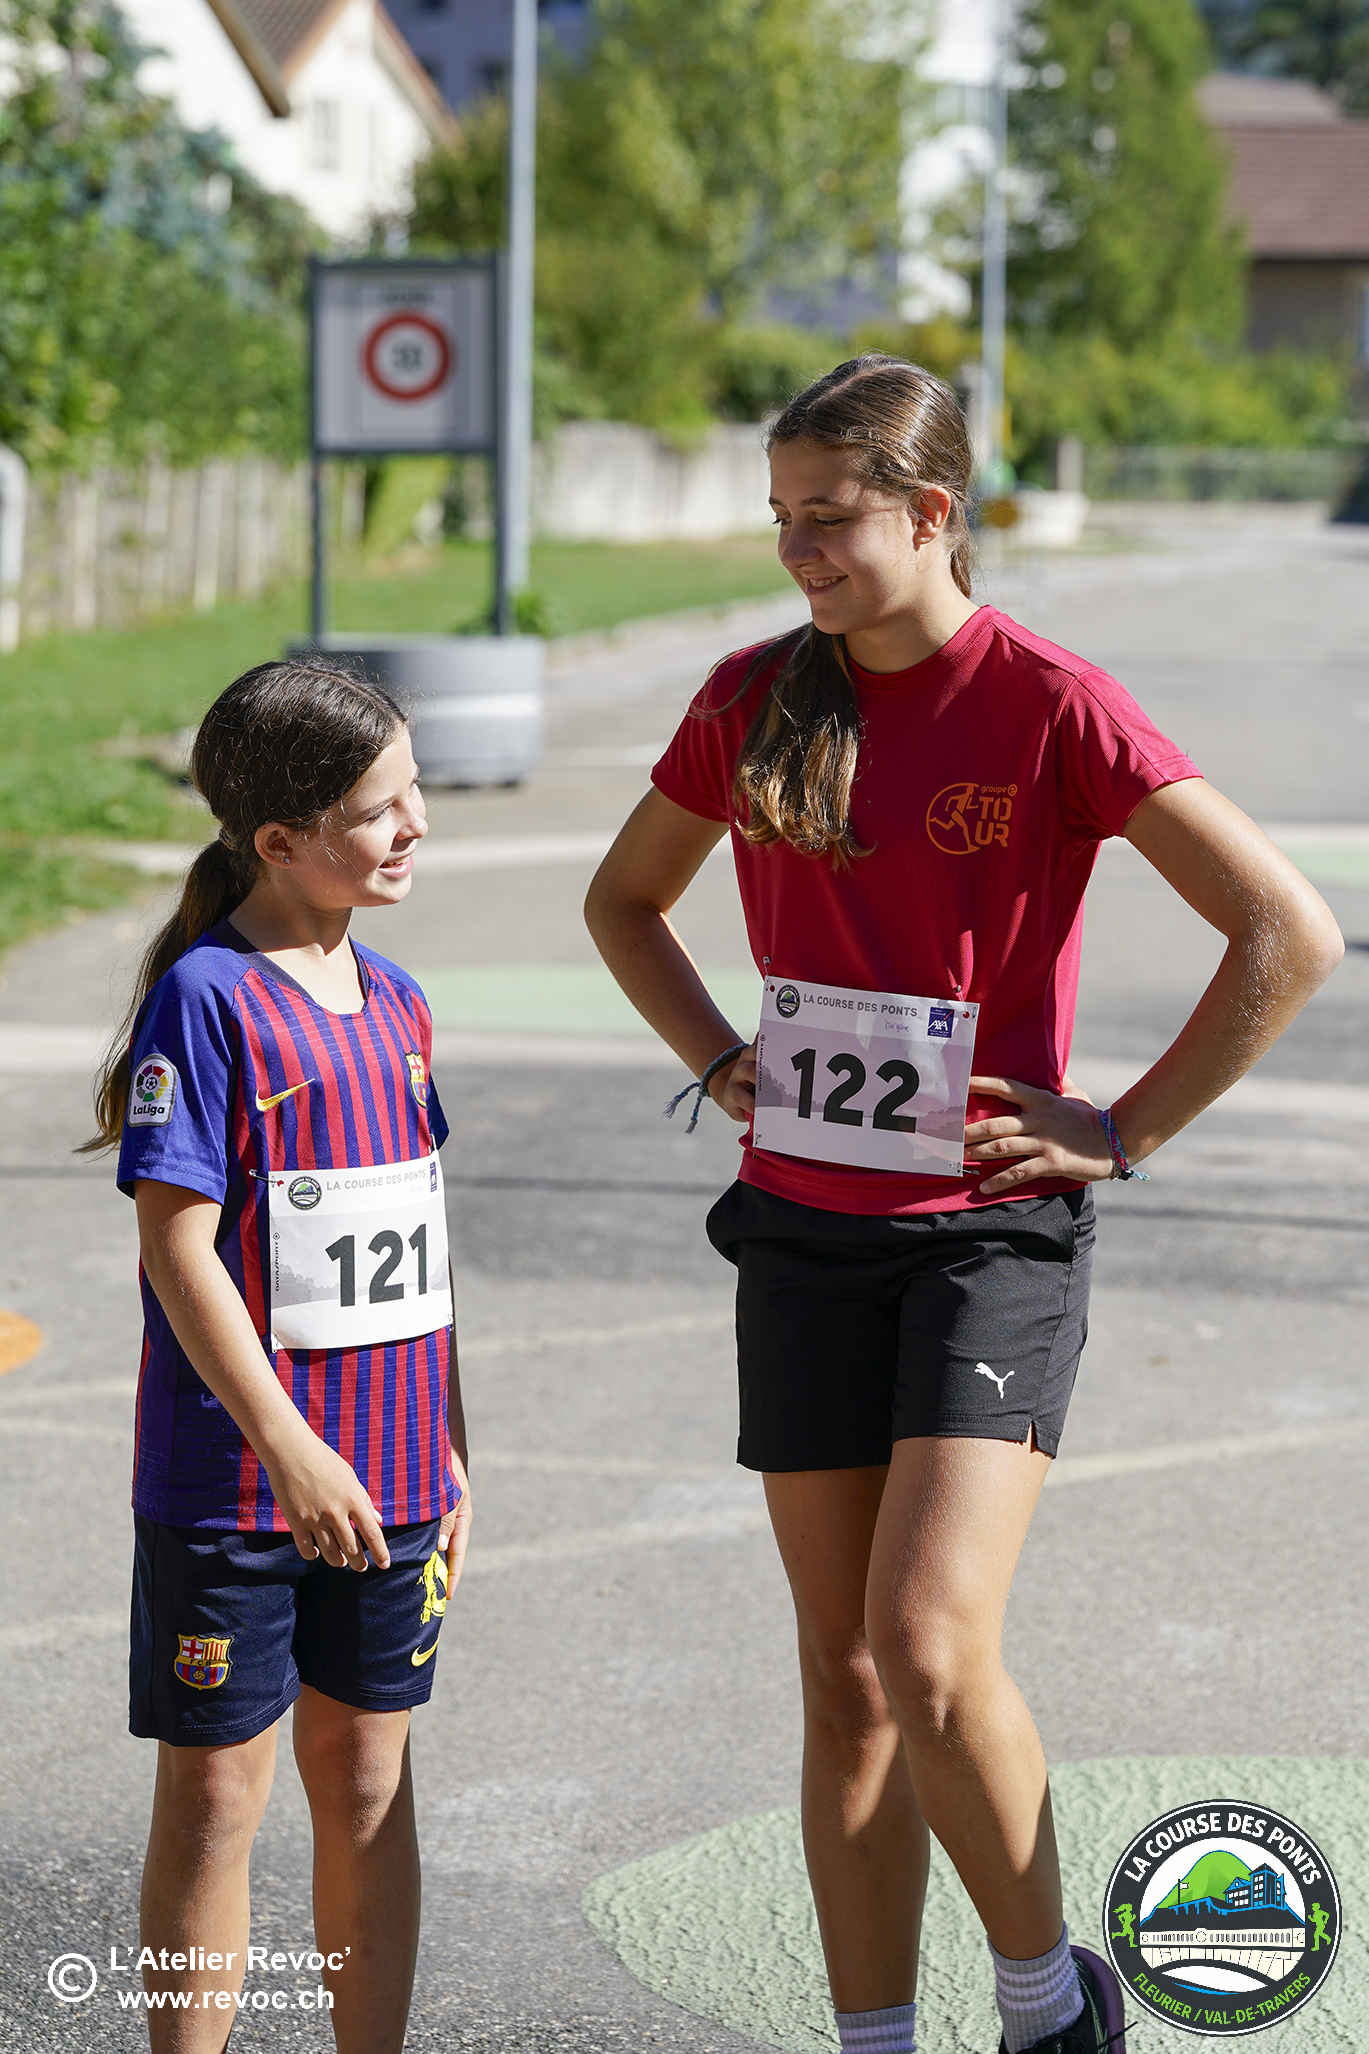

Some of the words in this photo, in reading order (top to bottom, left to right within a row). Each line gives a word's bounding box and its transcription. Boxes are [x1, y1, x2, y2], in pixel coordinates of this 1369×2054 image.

[981, 785, 1007, 795] groupe
[803, 993, 815, 1005] LA
[817, 995, 854, 1010] COURSE
[857, 1001, 878, 1013] DES
[881, 1004, 918, 1017] PONTS
[927, 1019, 949, 1031] AXA
[790, 1047, 920, 1134] 122
[133, 1103, 165, 1116] LaLiga
[326, 1180, 341, 1191] LA
[344, 1176, 383, 1190] COURSE
[386, 1174, 402, 1185] DES
[404, 1169, 427, 1182] PONTS
[325, 1223, 428, 1308] 121
